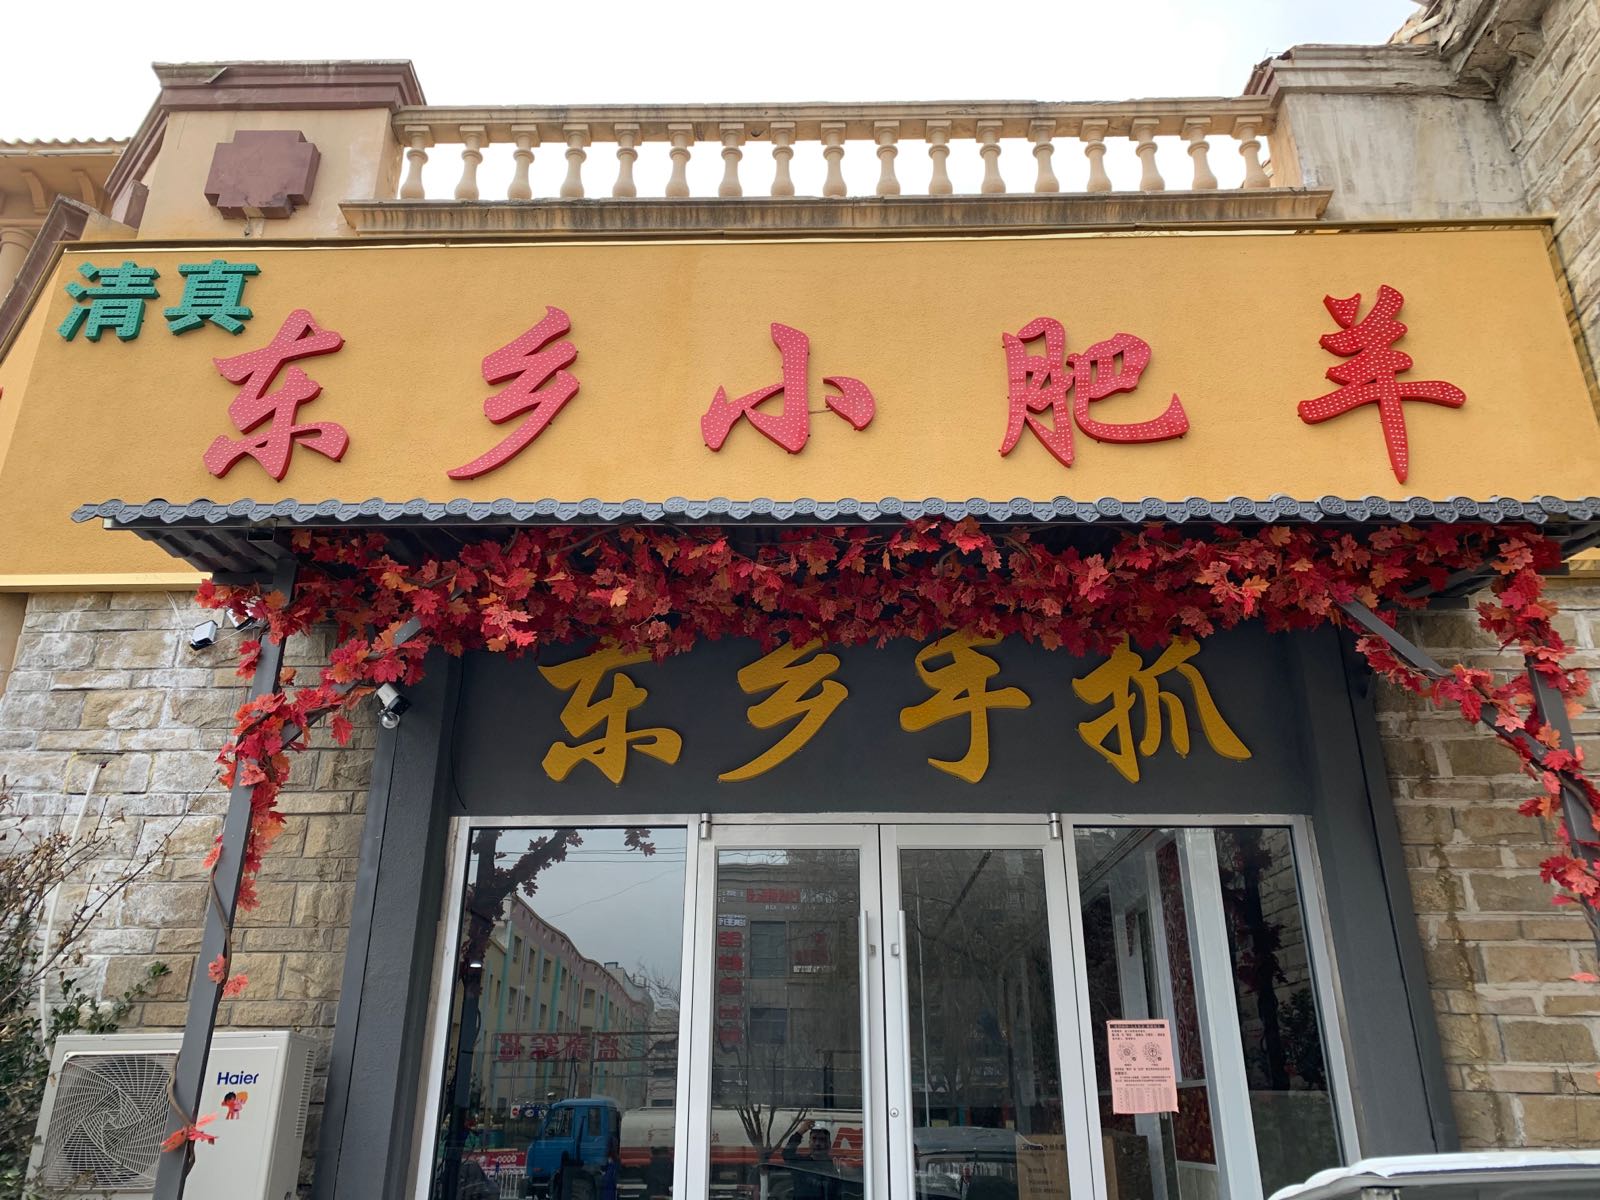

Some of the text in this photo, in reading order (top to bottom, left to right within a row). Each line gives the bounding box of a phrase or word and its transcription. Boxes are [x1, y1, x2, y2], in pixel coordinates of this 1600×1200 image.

[57, 259, 261, 343] 清真
[203, 284, 1467, 485] 东乡小肥羊
[537, 632, 1253, 784] 东乡手抓
[216, 1070, 260, 1086] Haier
